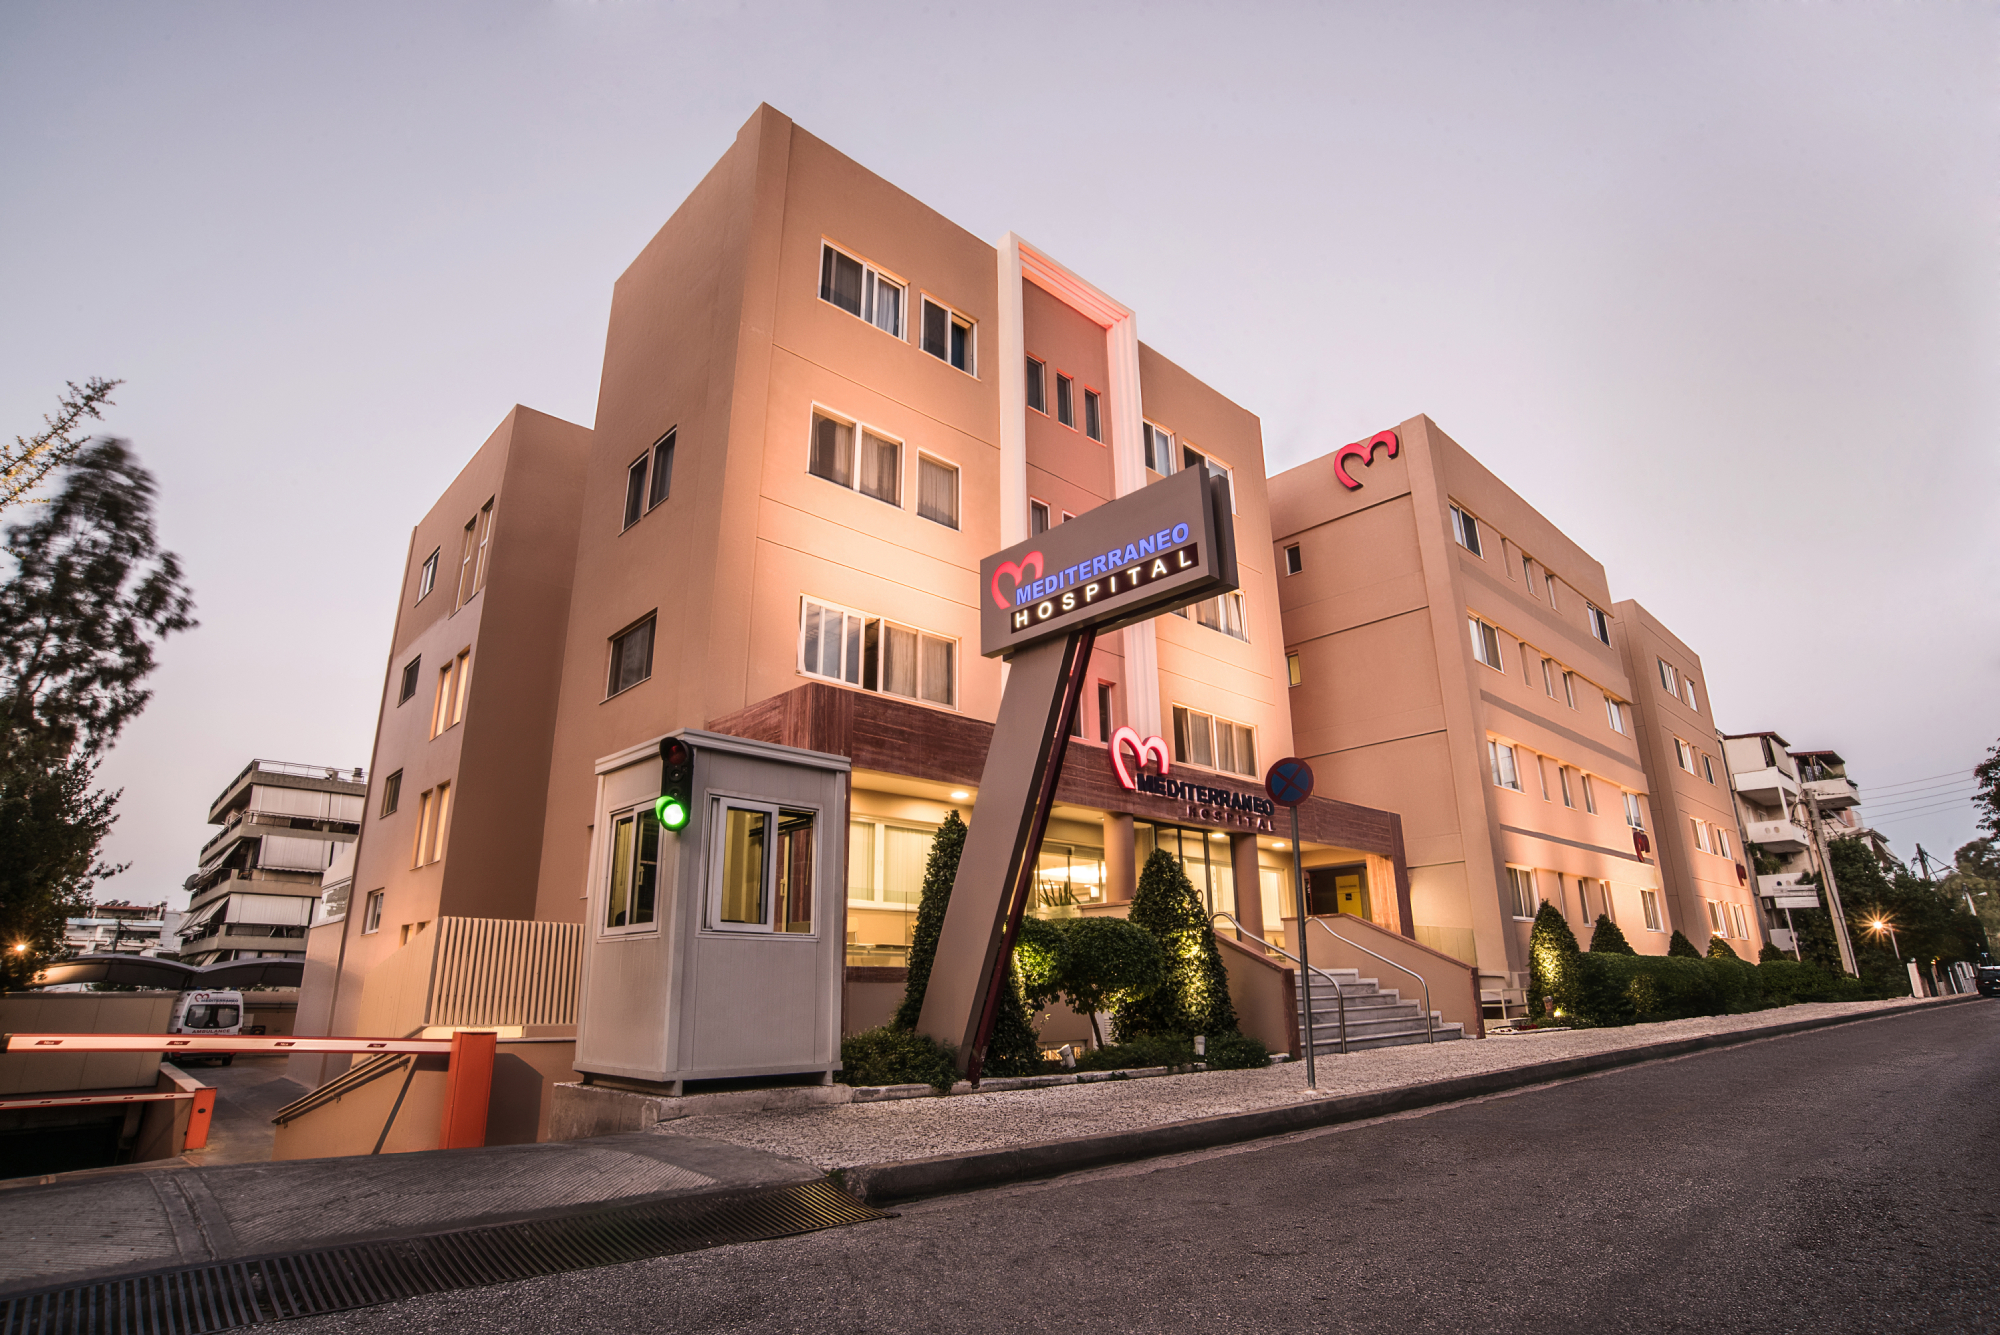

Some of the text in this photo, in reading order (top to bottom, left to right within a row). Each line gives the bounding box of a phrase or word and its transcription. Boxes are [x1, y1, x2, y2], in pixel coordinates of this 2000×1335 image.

[1014, 550, 1192, 628] HOSPITAL
[1016, 522, 1189, 606] MEDITERRANEO
[1136, 773, 1275, 816] MEDITERRANEO
[1186, 804, 1276, 832] HOSPITAL
